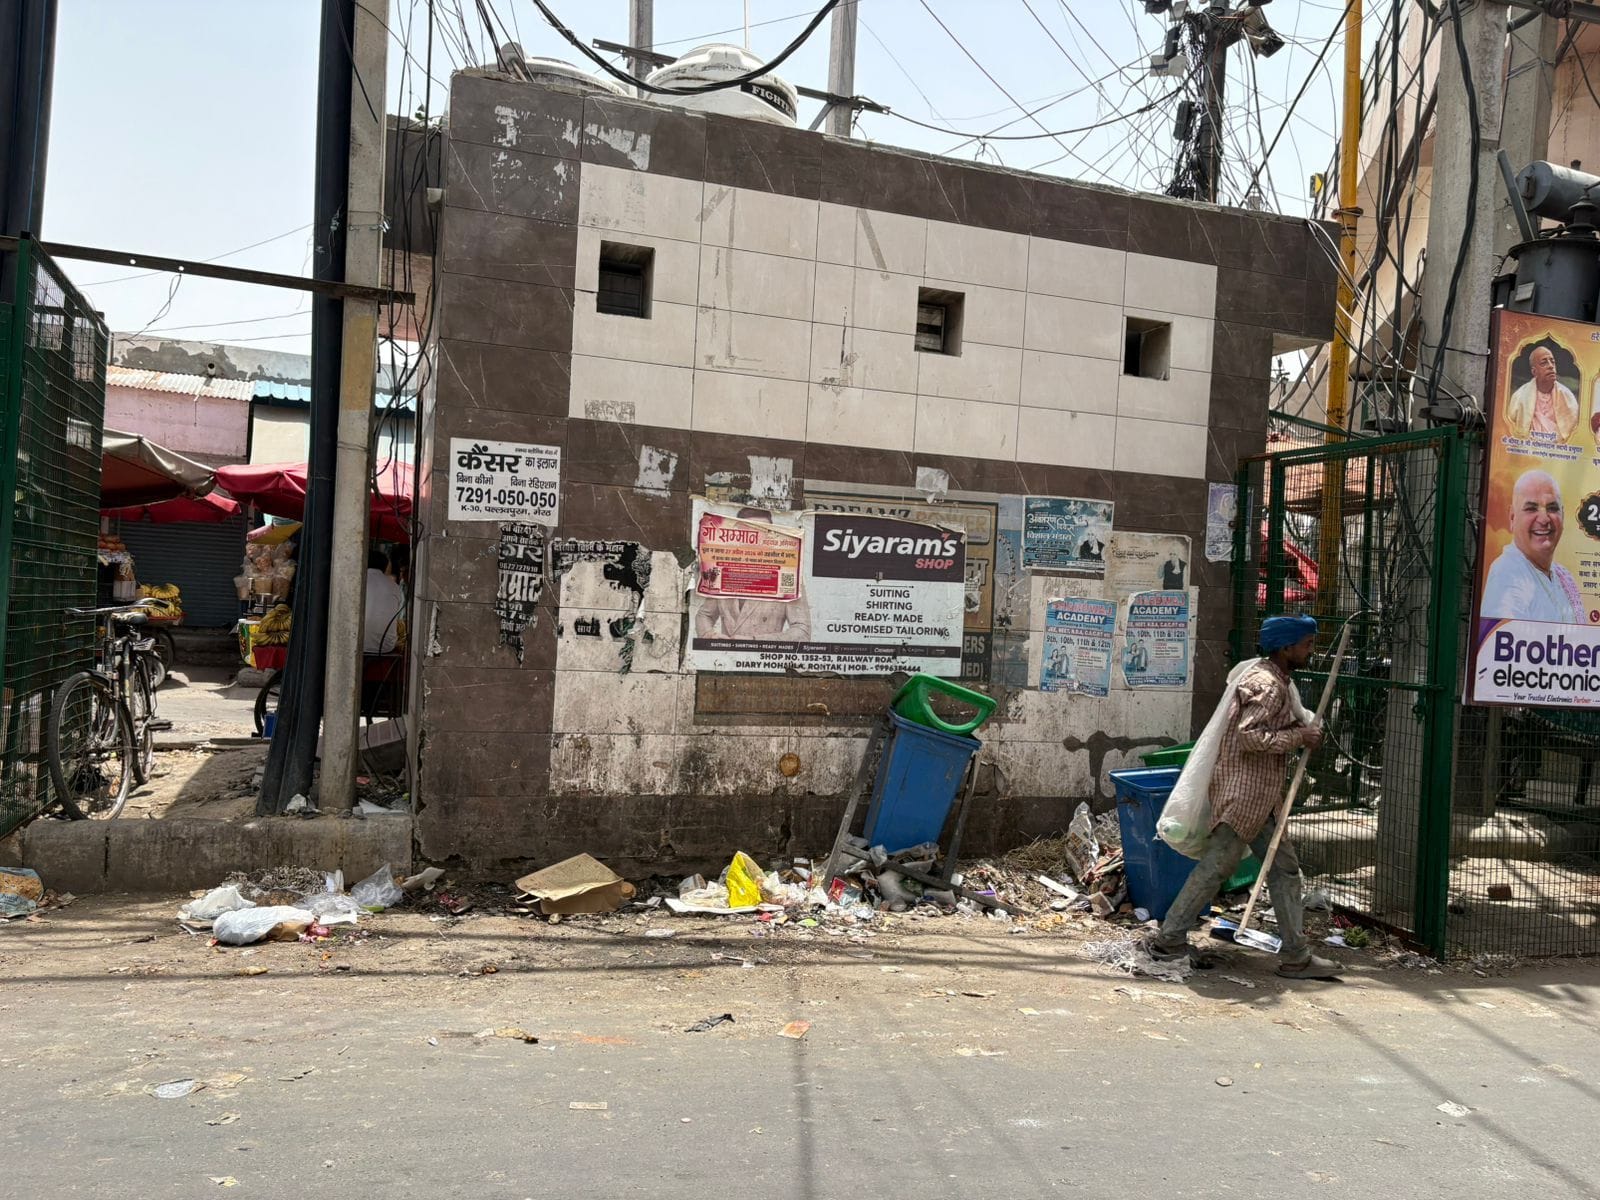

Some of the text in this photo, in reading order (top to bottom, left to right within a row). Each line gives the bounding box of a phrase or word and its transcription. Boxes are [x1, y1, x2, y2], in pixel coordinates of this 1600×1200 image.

[457, 443, 522, 474] कैंसर
[525, 456, 558, 470] का इलाज
[456, 472, 473, 483] बिना
[510, 476, 527, 488] बिना
[528, 477, 557, 490] रेडिएशन
[456, 486, 557, 509] 7291-050-050
[719, 528, 759, 545] सम्मान
[822, 528, 958, 559] Siyaram's
[915, 558, 954, 570] SHOP
[869, 588, 911, 599] SUITING
[866, 600, 913, 611] SHIRTING
[1132, 606, 1180, 615] ACADEMY
[854, 613, 924, 624] READY- MADE
[1056, 611, 1106, 624] ACADEMY
[826, 624, 950, 638] CUSTOMISED TAILORING
[1077, 638, 1090, 646] 11th
[1098, 640, 1111, 649] 12th
[1494, 631, 1600, 667] Brother
[759, 653, 783, 661] SHOP
[836, 656, 873, 664] RAILWAY
[874, 656, 898, 664] ROA
[735, 660, 761, 669] DIARY
[847, 663, 869, 672] MOB.
[1493, 663, 1600, 692] electronic
[1513, 692, 1527, 700] Your
[1527, 693, 1546, 702] Trusted
[1547, 694, 1573, 703] Electronics
